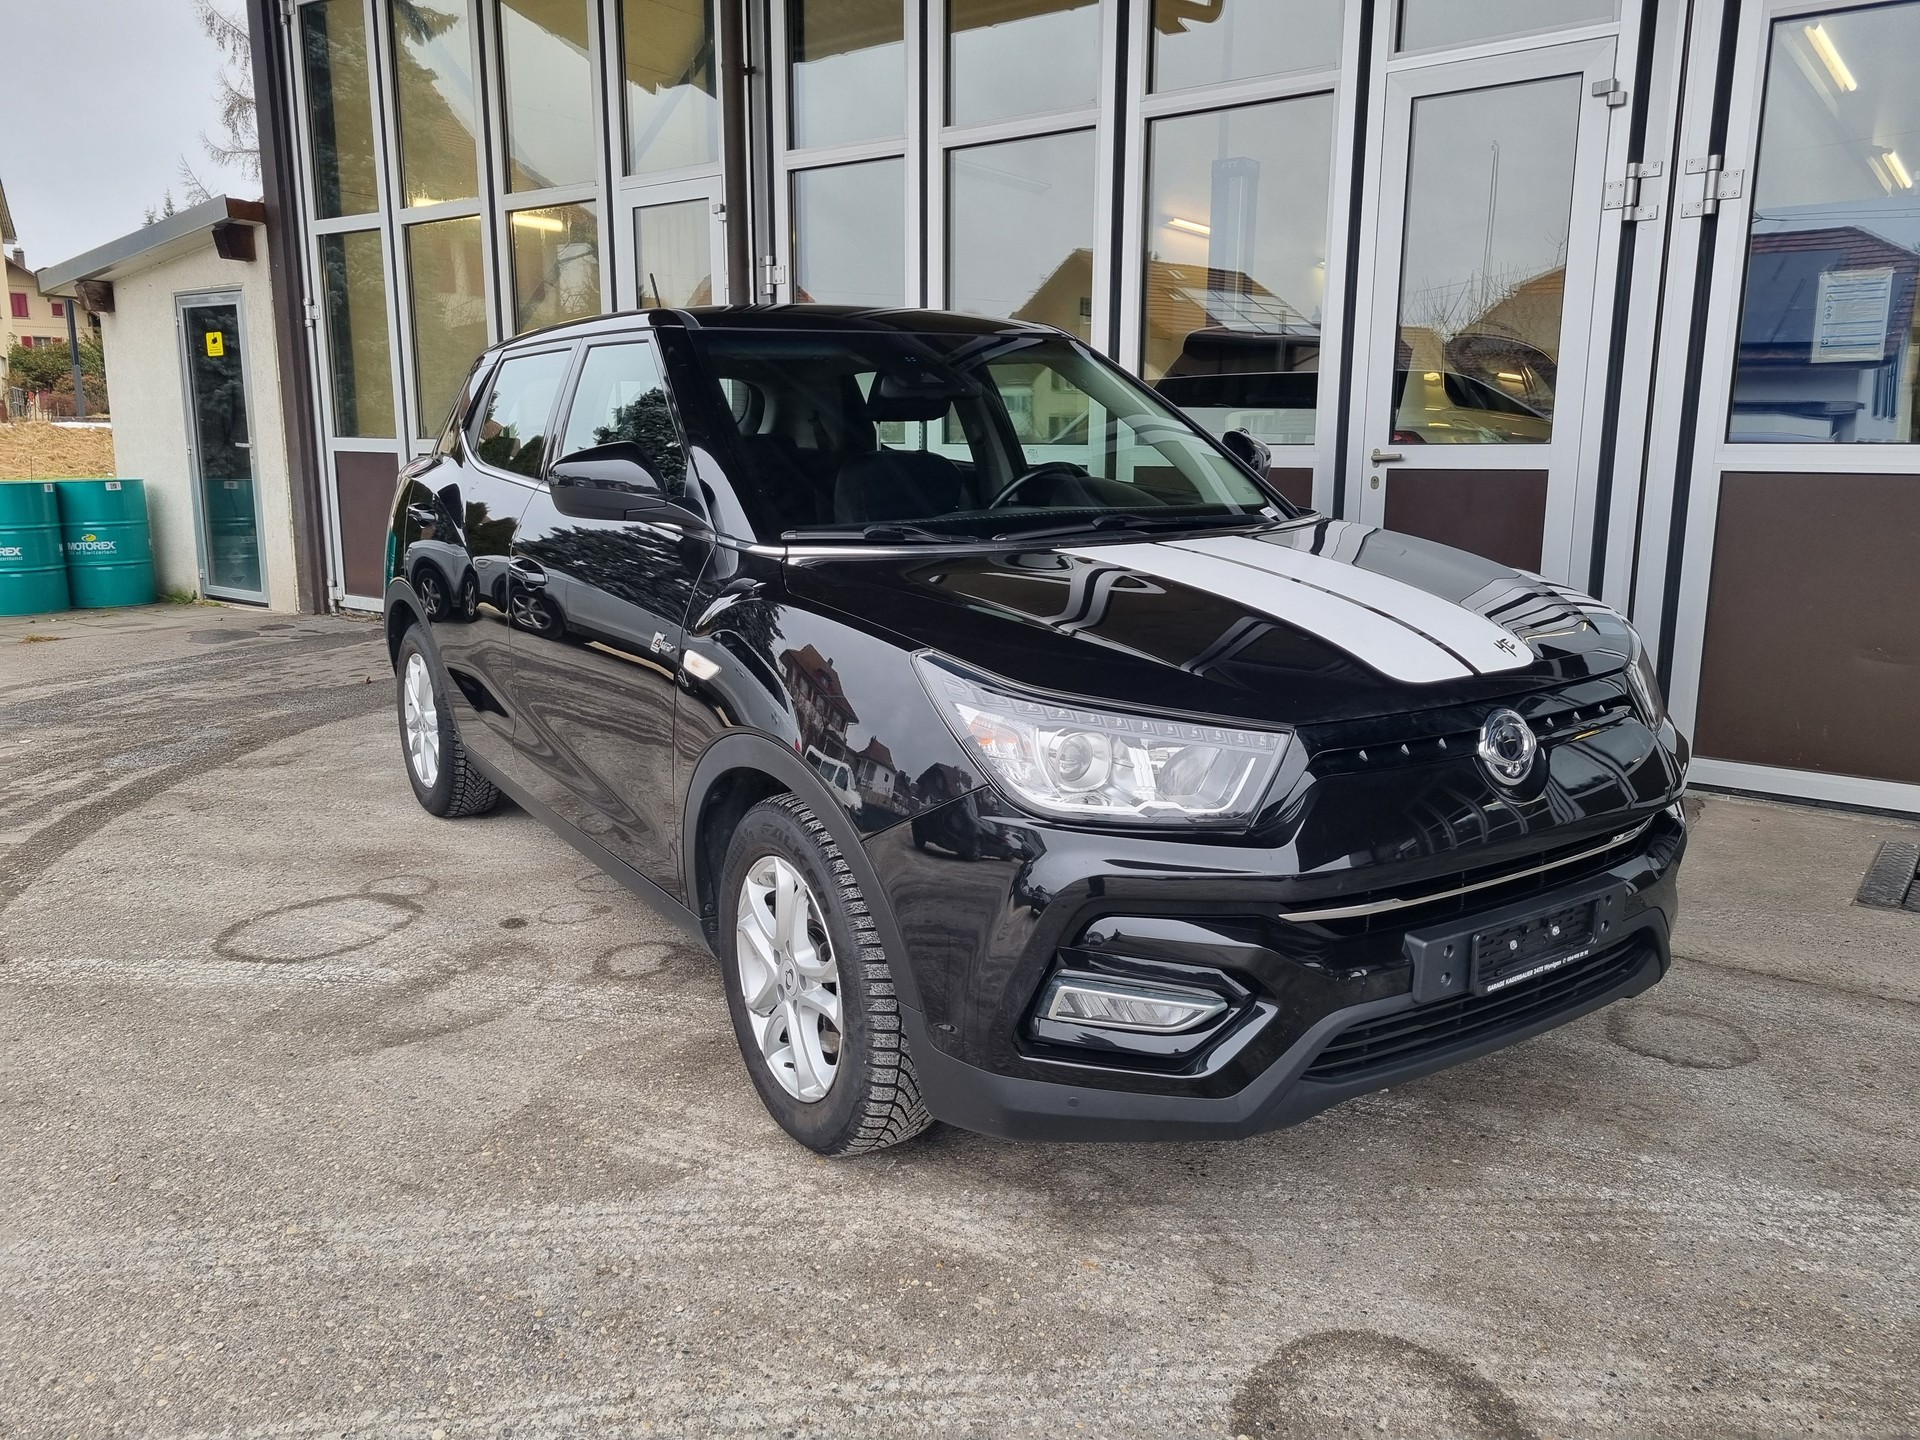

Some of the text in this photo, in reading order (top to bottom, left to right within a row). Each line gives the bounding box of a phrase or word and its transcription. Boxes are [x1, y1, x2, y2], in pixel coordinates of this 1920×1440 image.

[67, 541, 116, 551] MOTOREX
[760, 822, 831, 916] FALKEN
[1487, 980, 1505, 992] GARAGE
